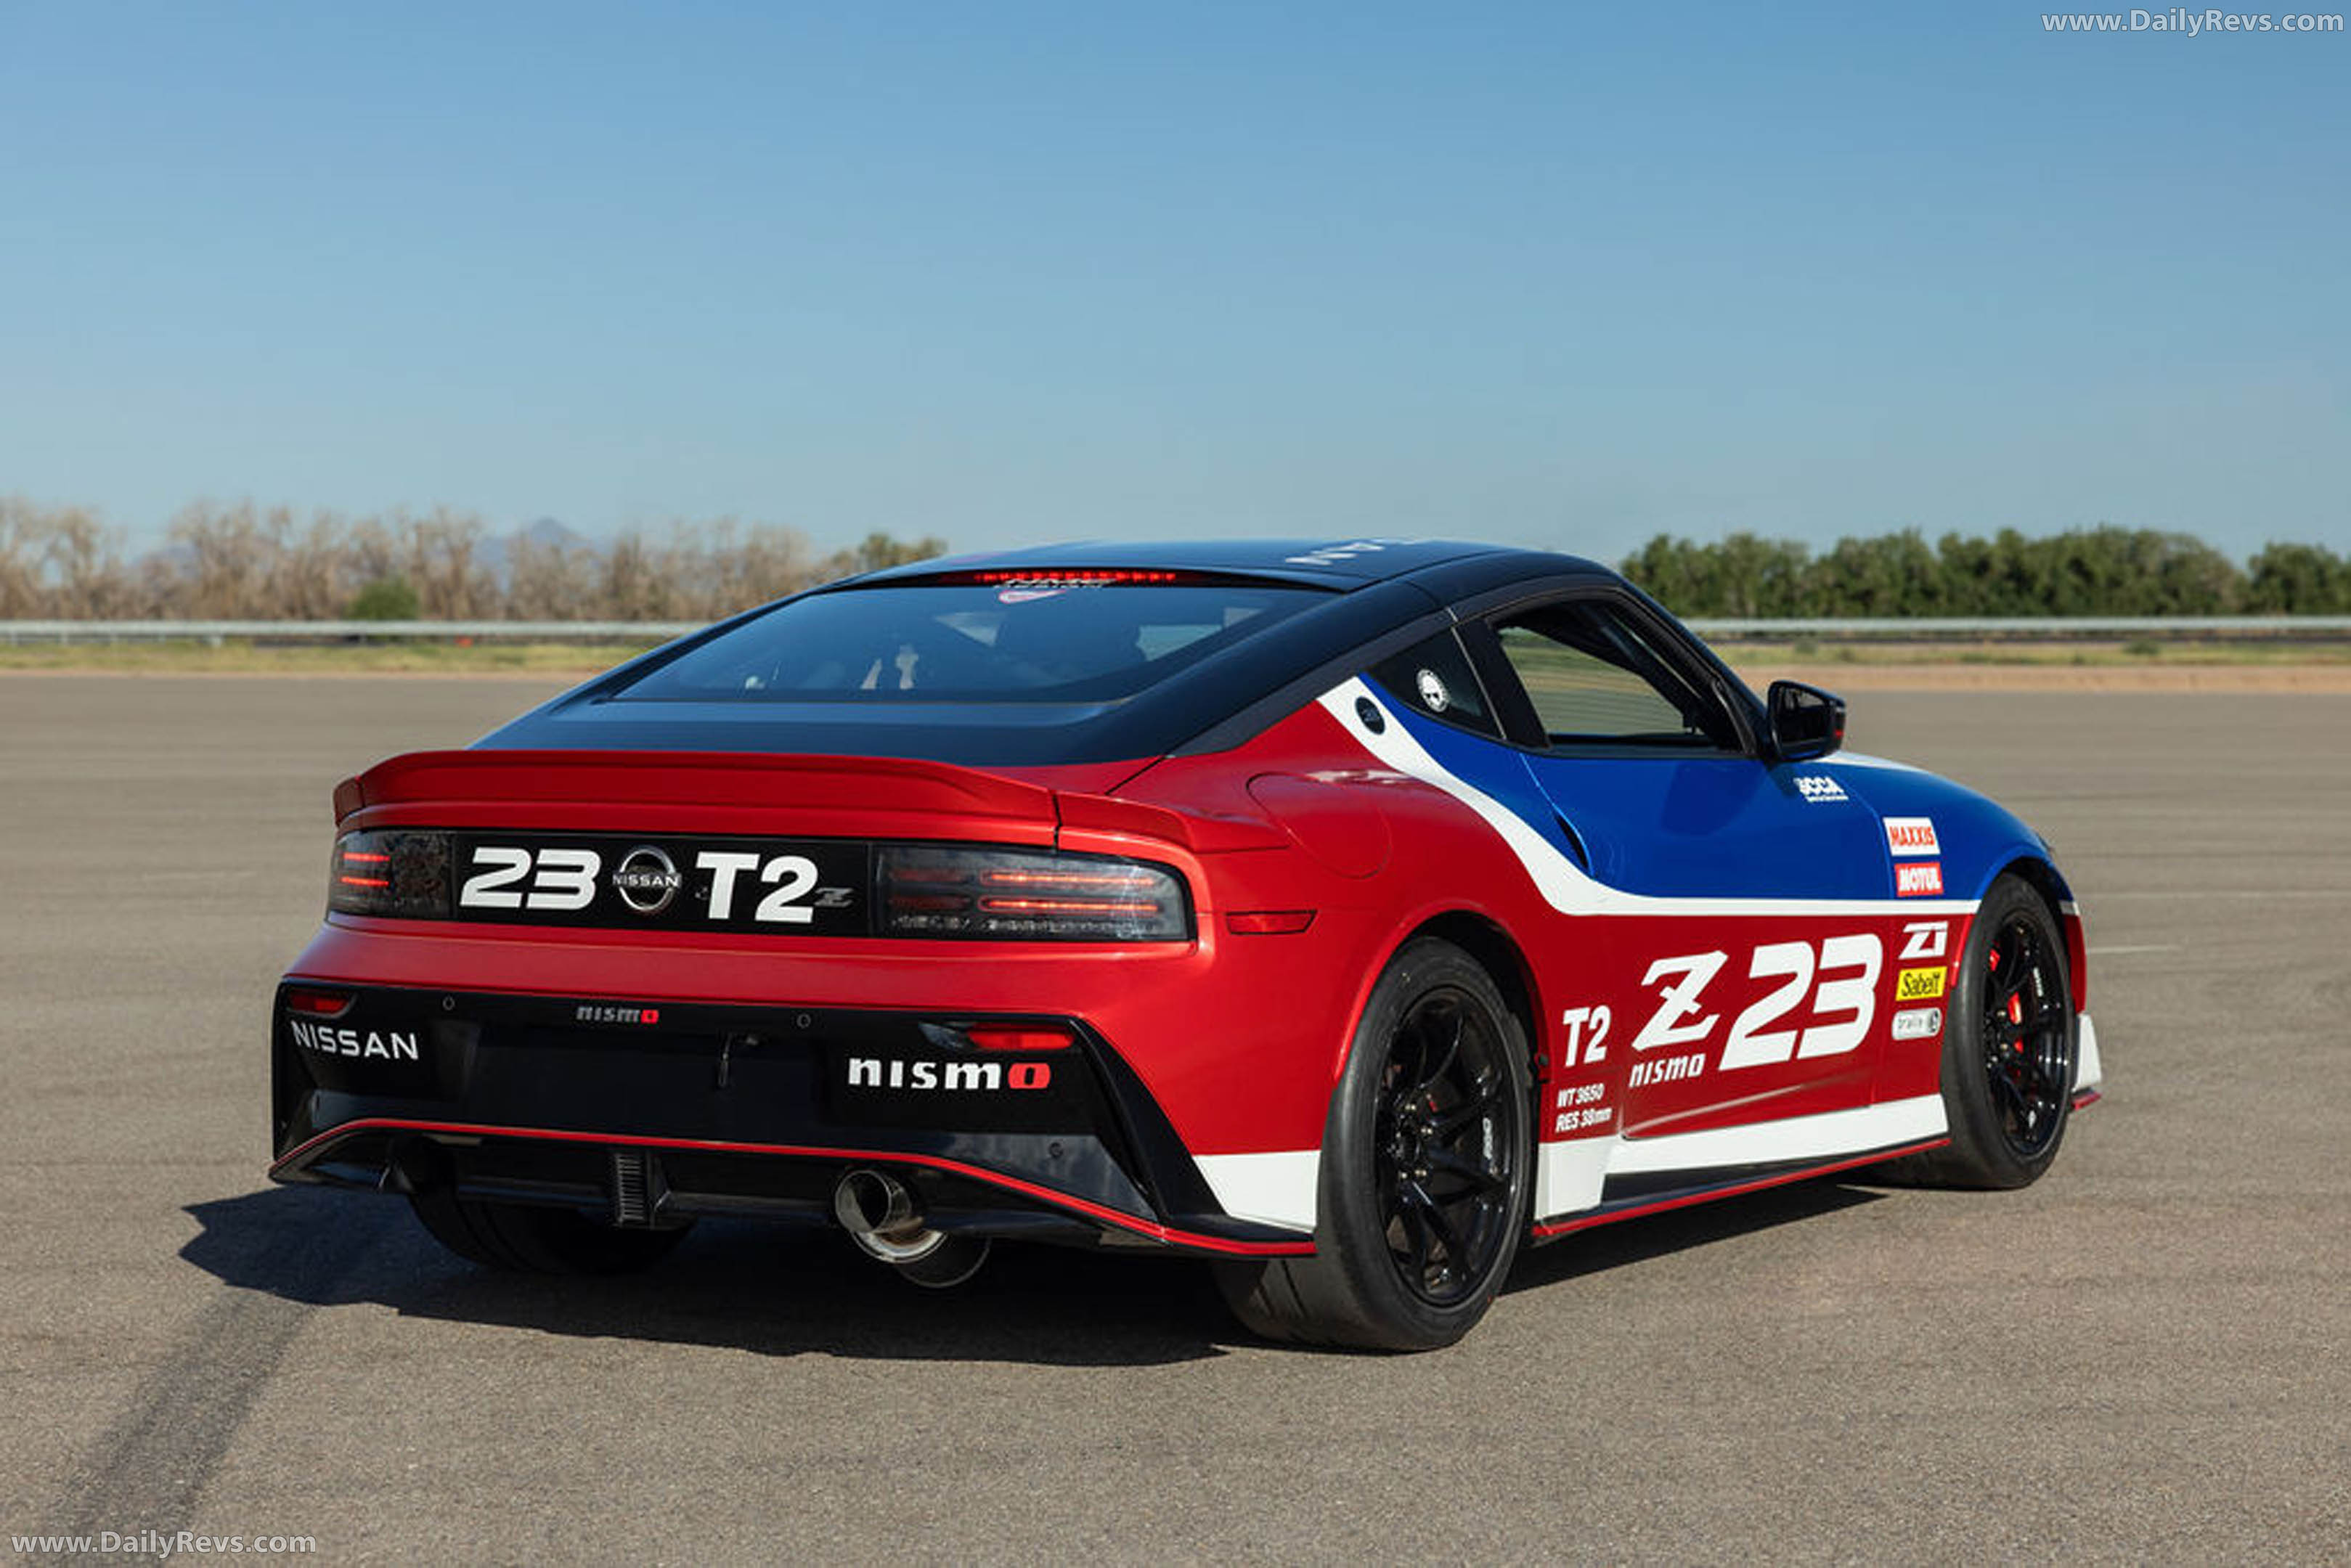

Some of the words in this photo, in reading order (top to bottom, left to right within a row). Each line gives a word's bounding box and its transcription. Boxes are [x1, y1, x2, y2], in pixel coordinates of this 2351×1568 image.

[460, 846, 601, 910] 23
[612, 873, 682, 888] NISSAN
[695, 852, 818, 923] T2
[1899, 867, 1941, 892] MOTUL
[1631, 950, 1729, 1051] Z
[1719, 933, 1883, 1071] 23
[290, 1019, 419, 1060] NISSAN
[1562, 1005, 1611, 1067] T2
